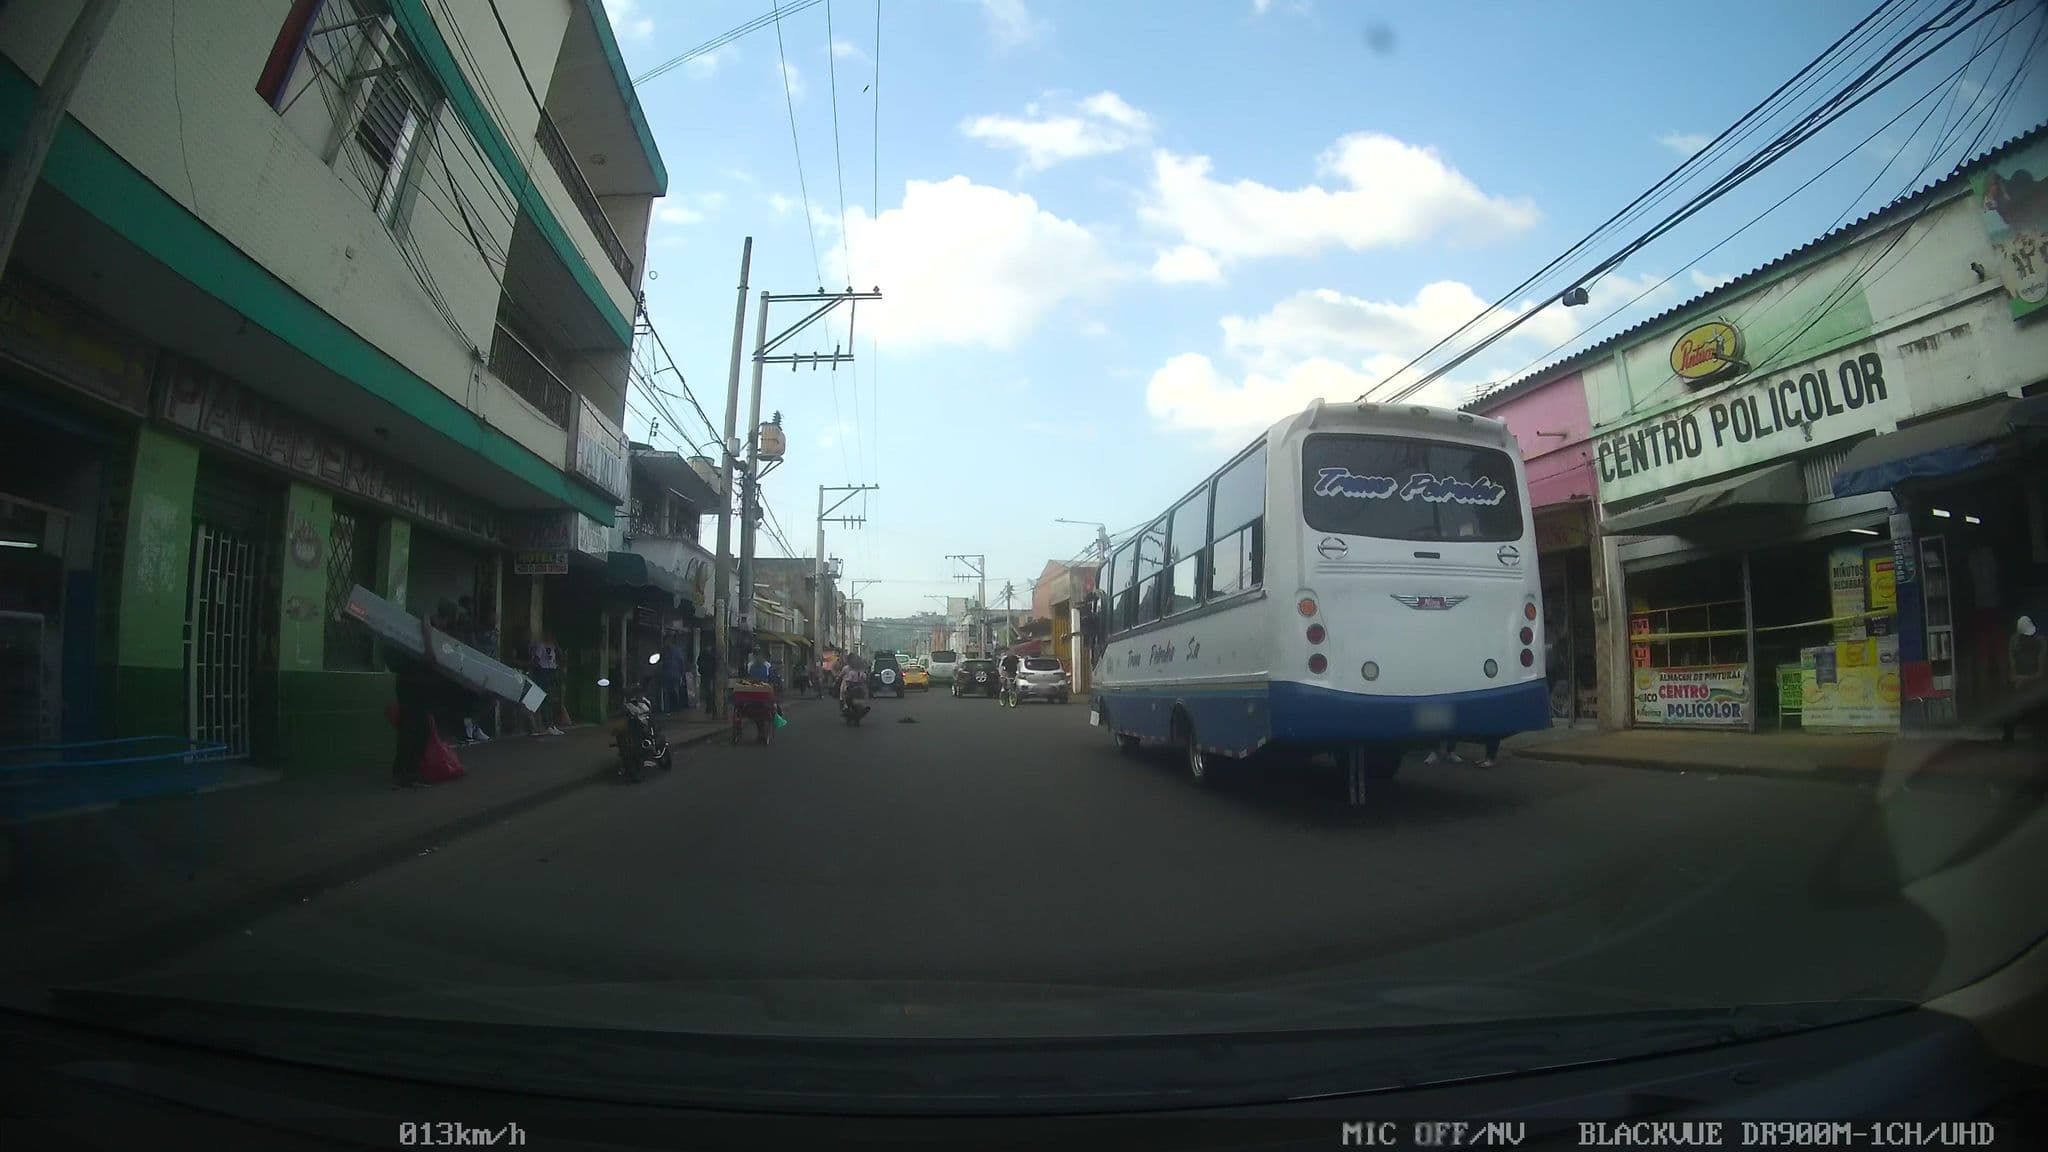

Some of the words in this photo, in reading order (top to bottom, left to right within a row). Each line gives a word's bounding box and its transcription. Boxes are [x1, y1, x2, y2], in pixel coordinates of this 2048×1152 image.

[1599, 414, 1703, 483] CENTRO
[1709, 351, 1888, 448] POLICOLOR
[1313, 467, 1399, 500] Trans
[1833, 564, 1865, 578] MINUTOS
[1659, 672, 1692, 682] ALMACEN
[1693, 672, 1703, 681] DE
[1704, 670, 1741, 681] PINTURAS
[1658, 683, 1709, 700] CENTRO
[1667, 702, 1741, 719] POLICOLOR
